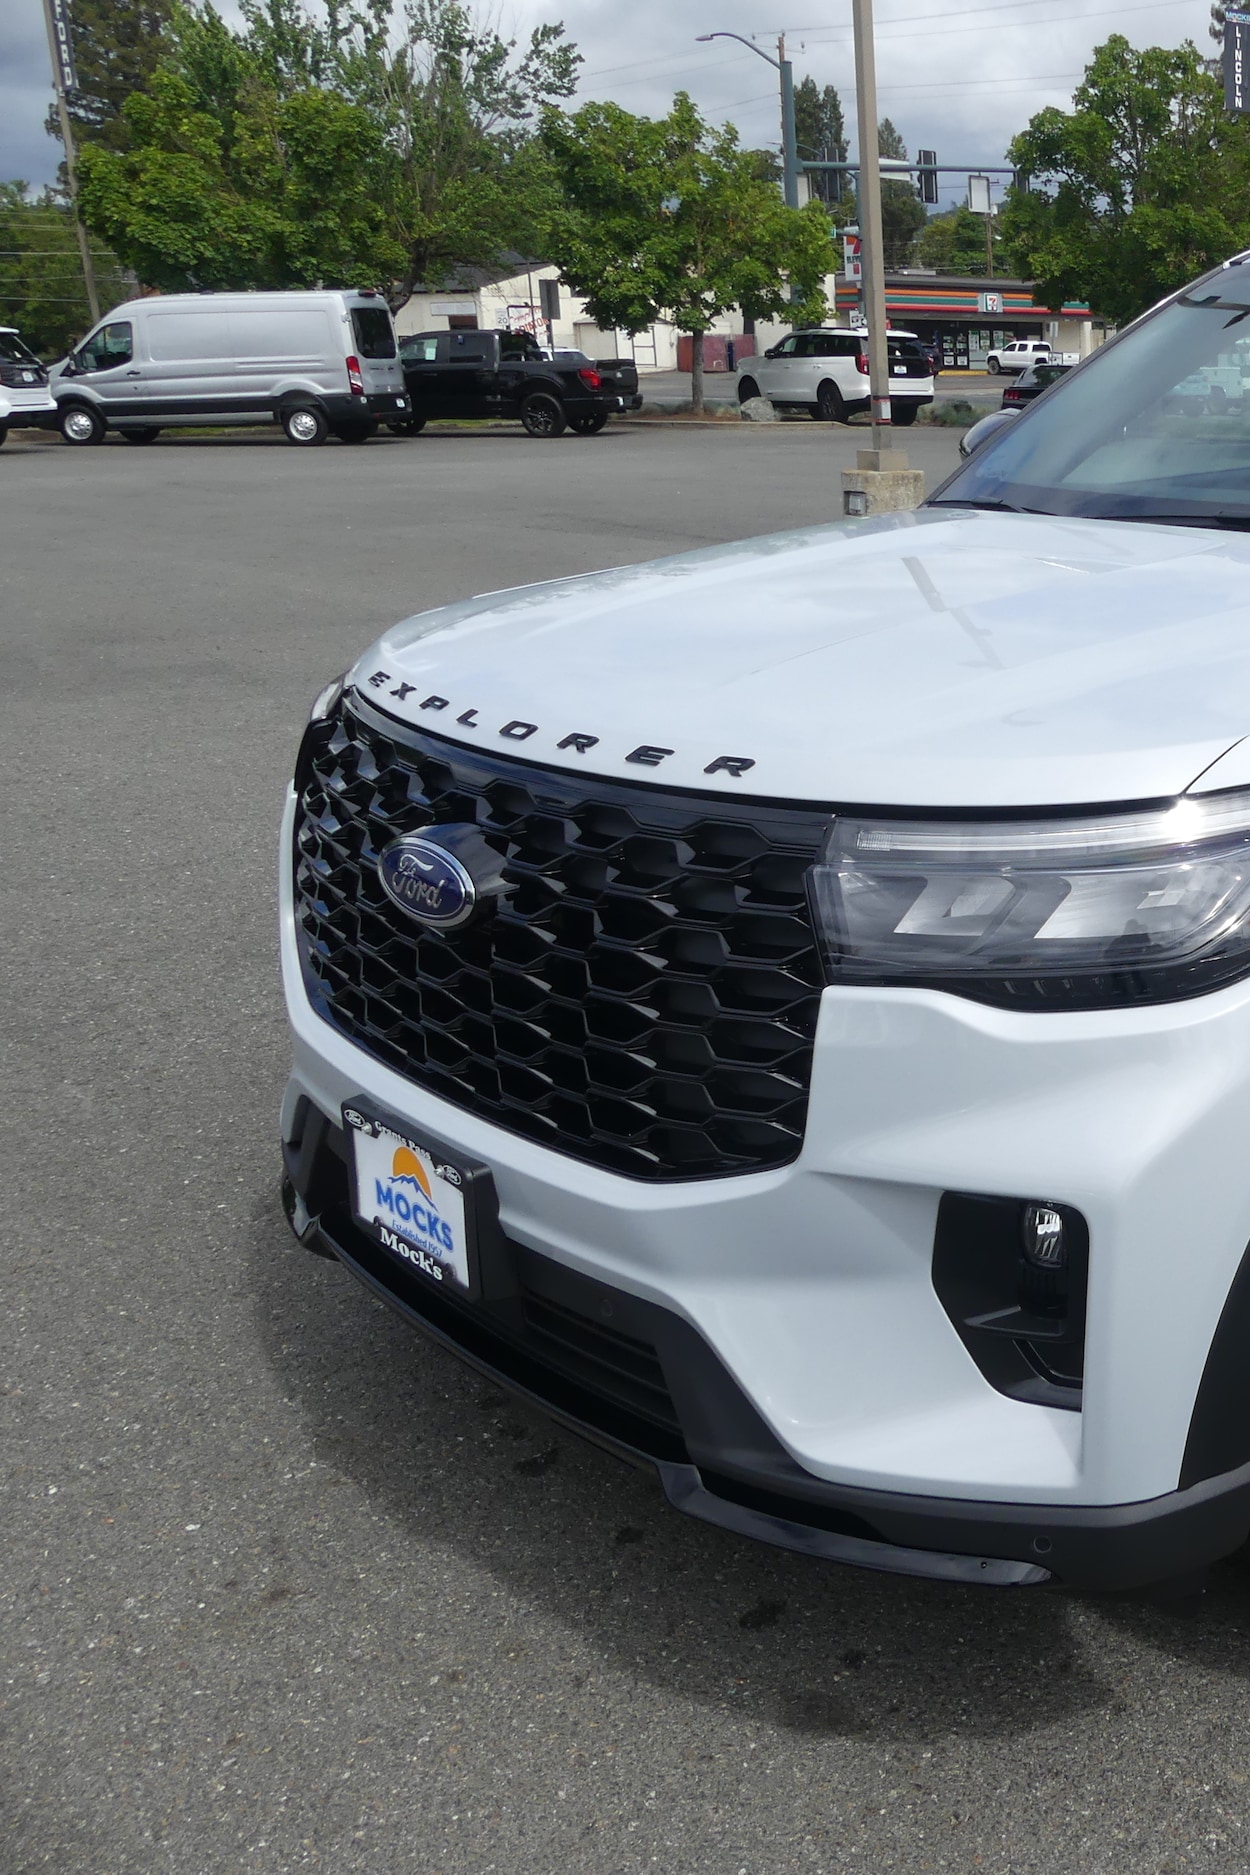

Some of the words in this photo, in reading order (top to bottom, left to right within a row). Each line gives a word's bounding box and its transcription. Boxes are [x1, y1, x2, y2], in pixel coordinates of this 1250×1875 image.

[54, 0, 72, 87] FORD
[497, 317, 508, 325] 20
[367, 670, 756, 778] EXPLORER
[392, 853, 445, 909] Ford
[374, 1120, 407, 1147] Grants
[408, 1139, 432, 1160] Pass
[375, 1177, 453, 1252] MOCKS
[392, 1220, 428, 1247] Established
[428, 1240, 443, 1258] 1957
[379, 1226, 443, 1281] Mock's
